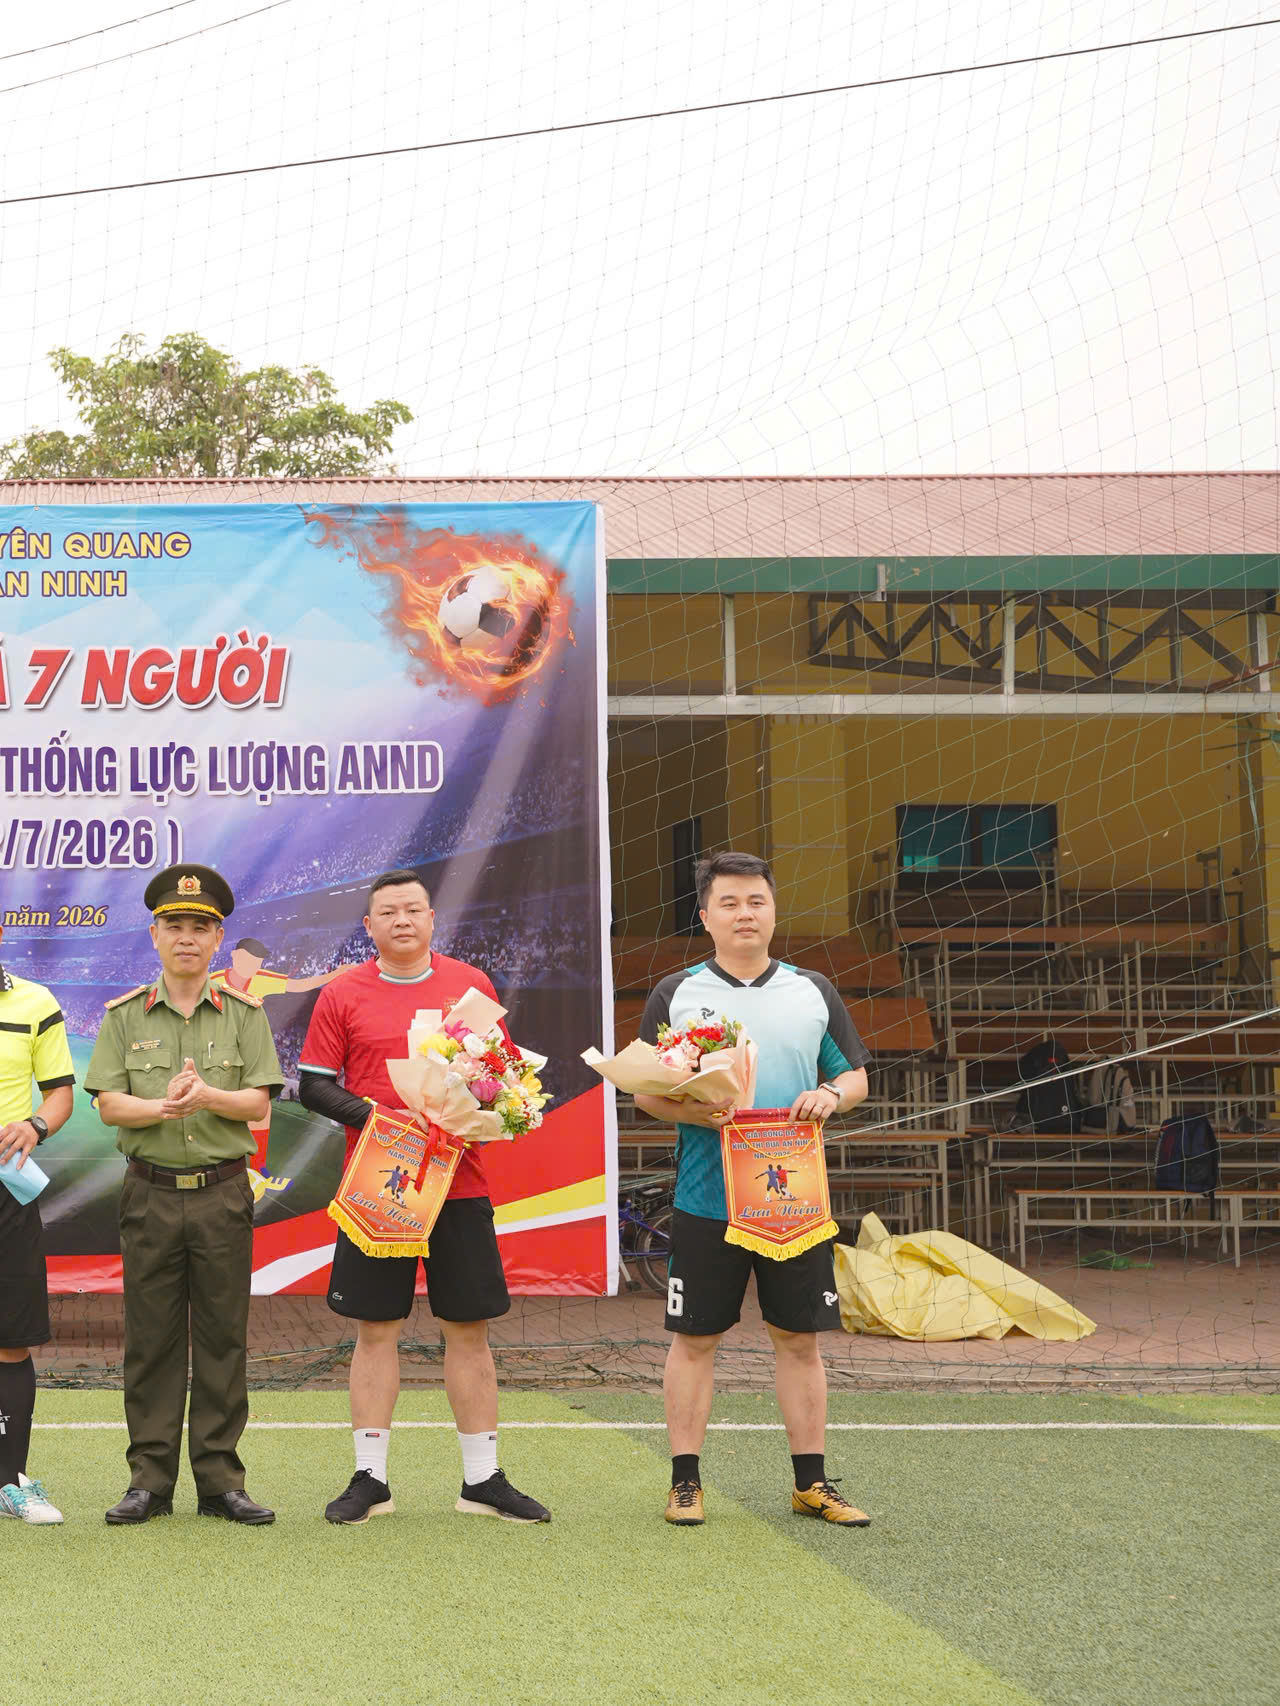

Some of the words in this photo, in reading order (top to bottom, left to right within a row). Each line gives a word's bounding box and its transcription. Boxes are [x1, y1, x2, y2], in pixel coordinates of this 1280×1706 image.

[63, 532, 192, 560] QUANG
[42, 571, 128, 597] NINH
[24, 649, 70, 706] 7
[81, 629, 288, 706] NGƯỜI
[0, 730, 117, 793] THỐNG
[130, 741, 196, 803] LỰC
[209, 741, 325, 803] LƯỢNG
[339, 743, 440, 791] ANND
[3, 905, 51, 927] năm
[56, 905, 108, 926] 2026
[782, 1138, 793, 1147] AN
[667, 1276, 683, 1317] 6
